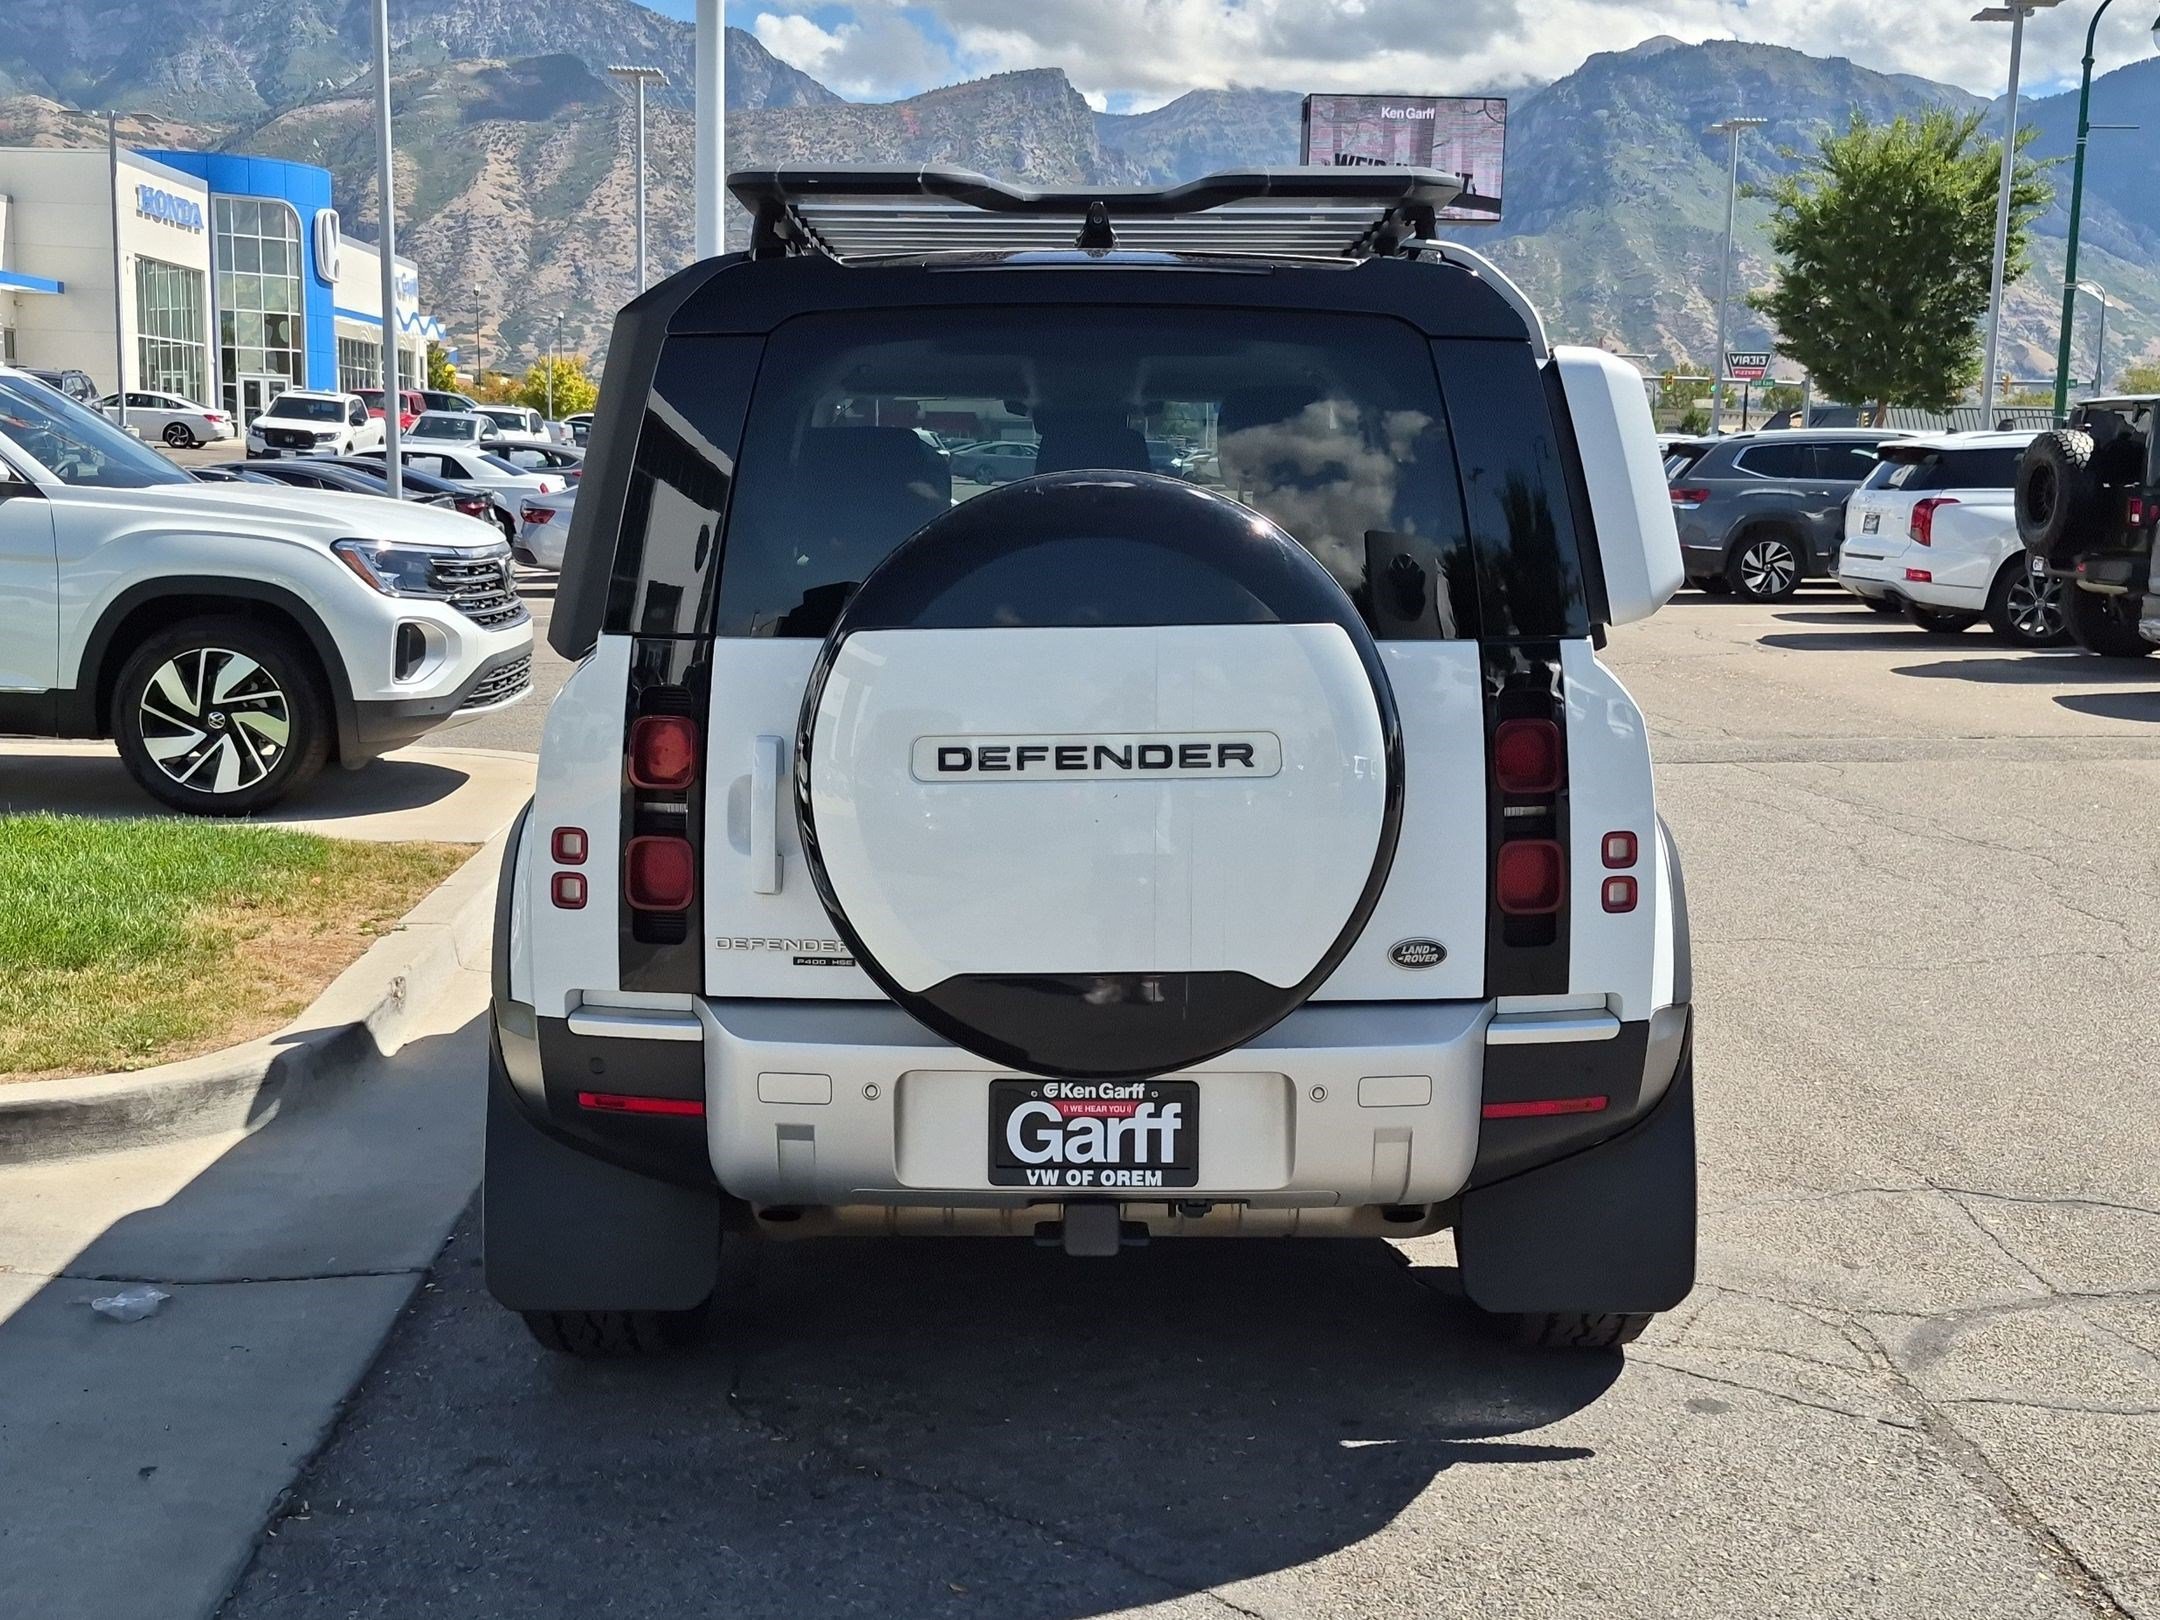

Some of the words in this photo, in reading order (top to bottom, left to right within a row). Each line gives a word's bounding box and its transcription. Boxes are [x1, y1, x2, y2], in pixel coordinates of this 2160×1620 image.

[1381, 107, 1404, 119] Ken
[1405, 107, 1435, 120] Garff
[137, 184, 204, 230] HONDA
[937, 743, 1255, 772] DEFENDER
[1401, 945, 1430, 954] LAND
[1403, 954, 1438, 963] ROVER
[1060, 1083, 1096, 1099] Ken
[1098, 1083, 1145, 1099] Garff
[1085, 1105, 1107, 1113] HEAR
[1109, 1105, 1125, 1113] YOU
[1006, 1101, 1182, 1164] Garff
[1026, 1169, 1059, 1186] VW
[1065, 1169, 1093, 1186] OF
[1100, 1169, 1163, 1186] OREM
